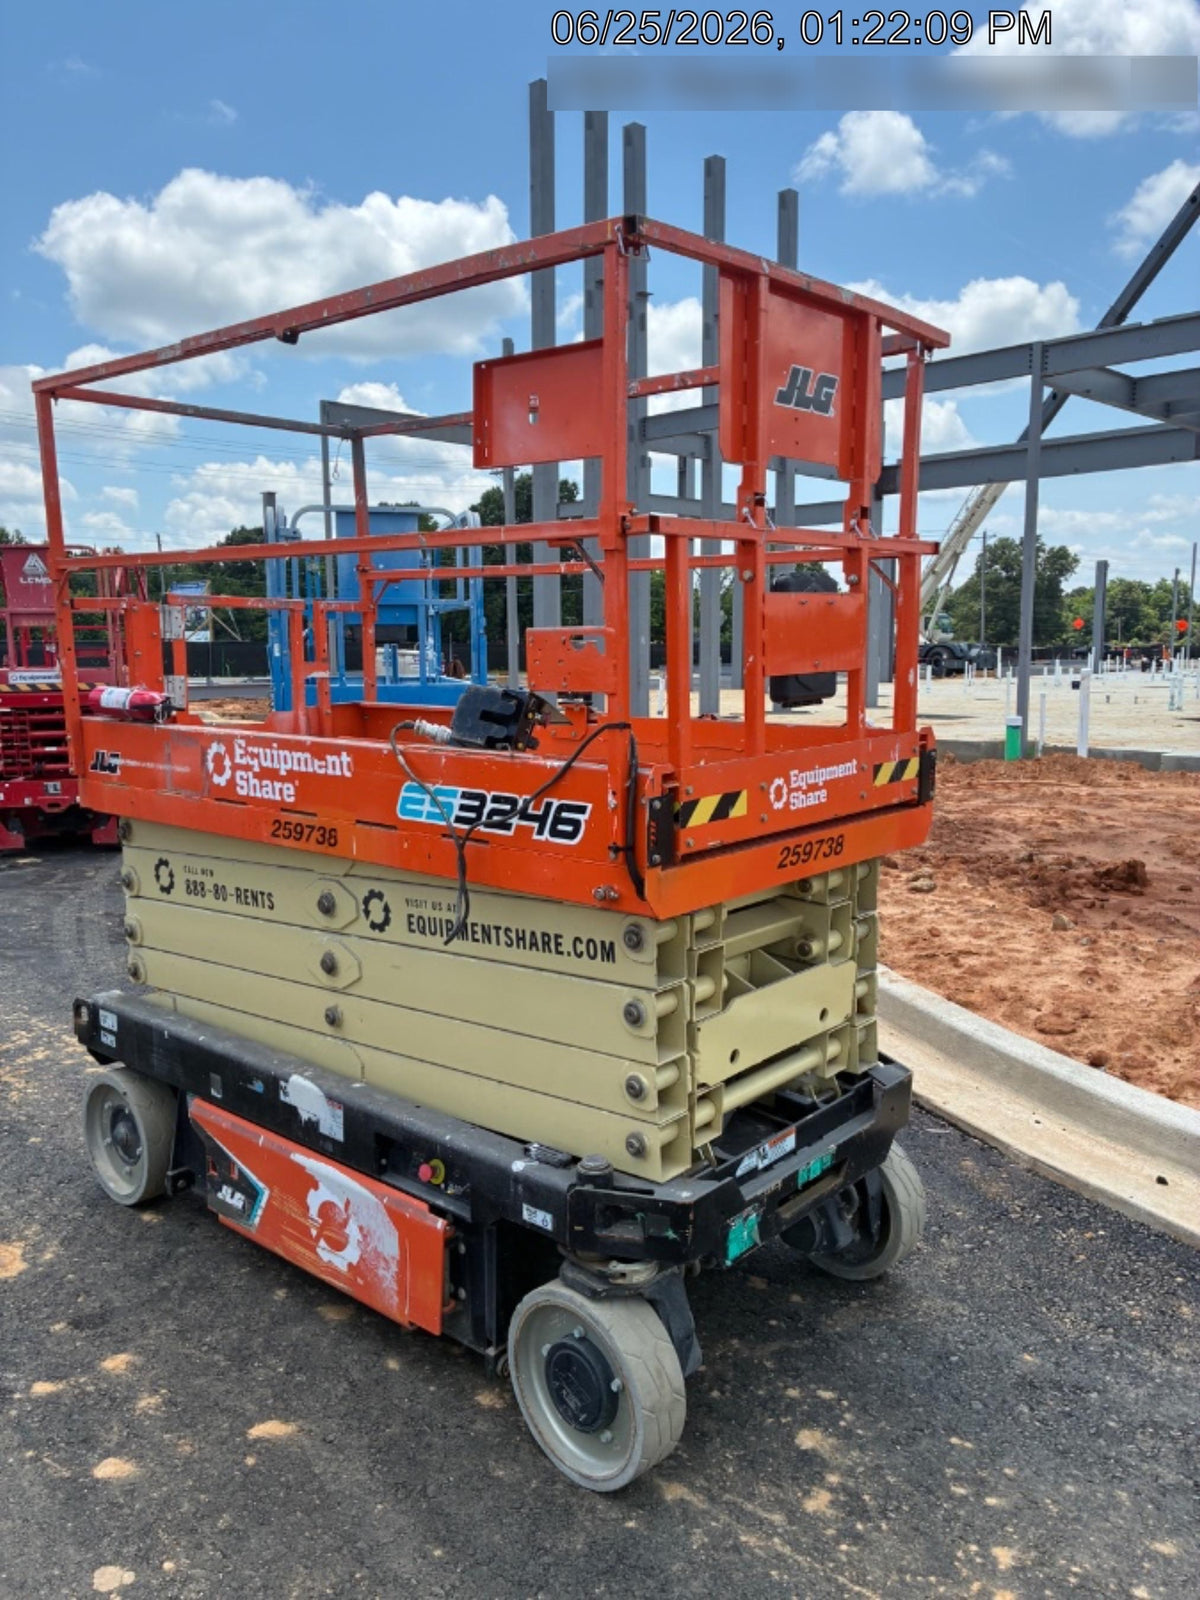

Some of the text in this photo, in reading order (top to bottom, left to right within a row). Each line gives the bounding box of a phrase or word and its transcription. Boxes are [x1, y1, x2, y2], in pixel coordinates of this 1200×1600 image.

[774, 364, 840, 417] JLG
[233, 739, 353, 778] Equipment
[789, 758, 858, 790] Equipment
[235, 770, 296, 803] Share
[789, 788, 828, 811] Share
[396, 780, 592, 845] ES3246
[271, 820, 339, 848] 259738
[777, 834, 845, 870] 259738
[184, 878, 275, 911] 888-80-RENTS
[405, 897, 428, 909] VISIT
[431, 901, 443, 912] US
[216, 1184, 246, 1211] JLG
